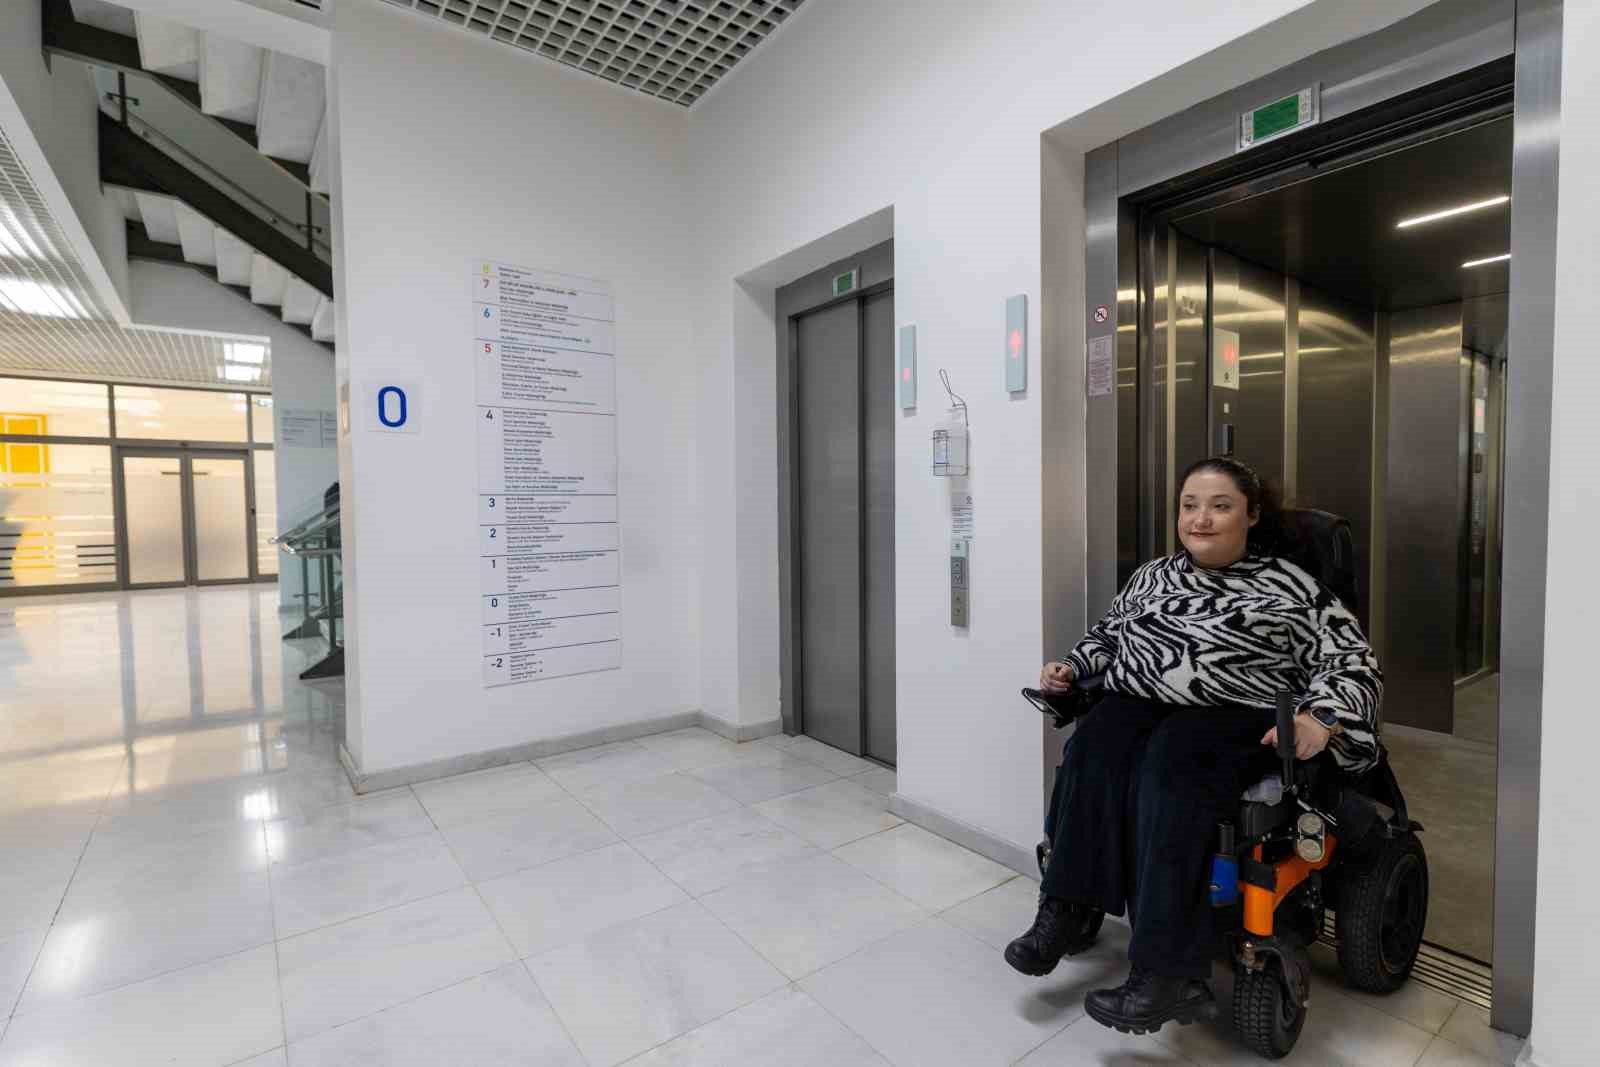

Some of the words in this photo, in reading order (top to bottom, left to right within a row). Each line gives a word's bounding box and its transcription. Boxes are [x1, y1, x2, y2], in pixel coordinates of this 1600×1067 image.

[482, 279, 490, 288] 7
[483, 308, 490, 318] 6
[484, 344, 492, 353] 5
[378, 386, 407, 428] 0
[485, 410, 493, 420] 4
[488, 498, 496, 508] 3
[489, 528, 497, 538] 2
[491, 598, 498, 608] 0
[490, 628, 501, 637] -1
[491, 658, 503, 668] -2
